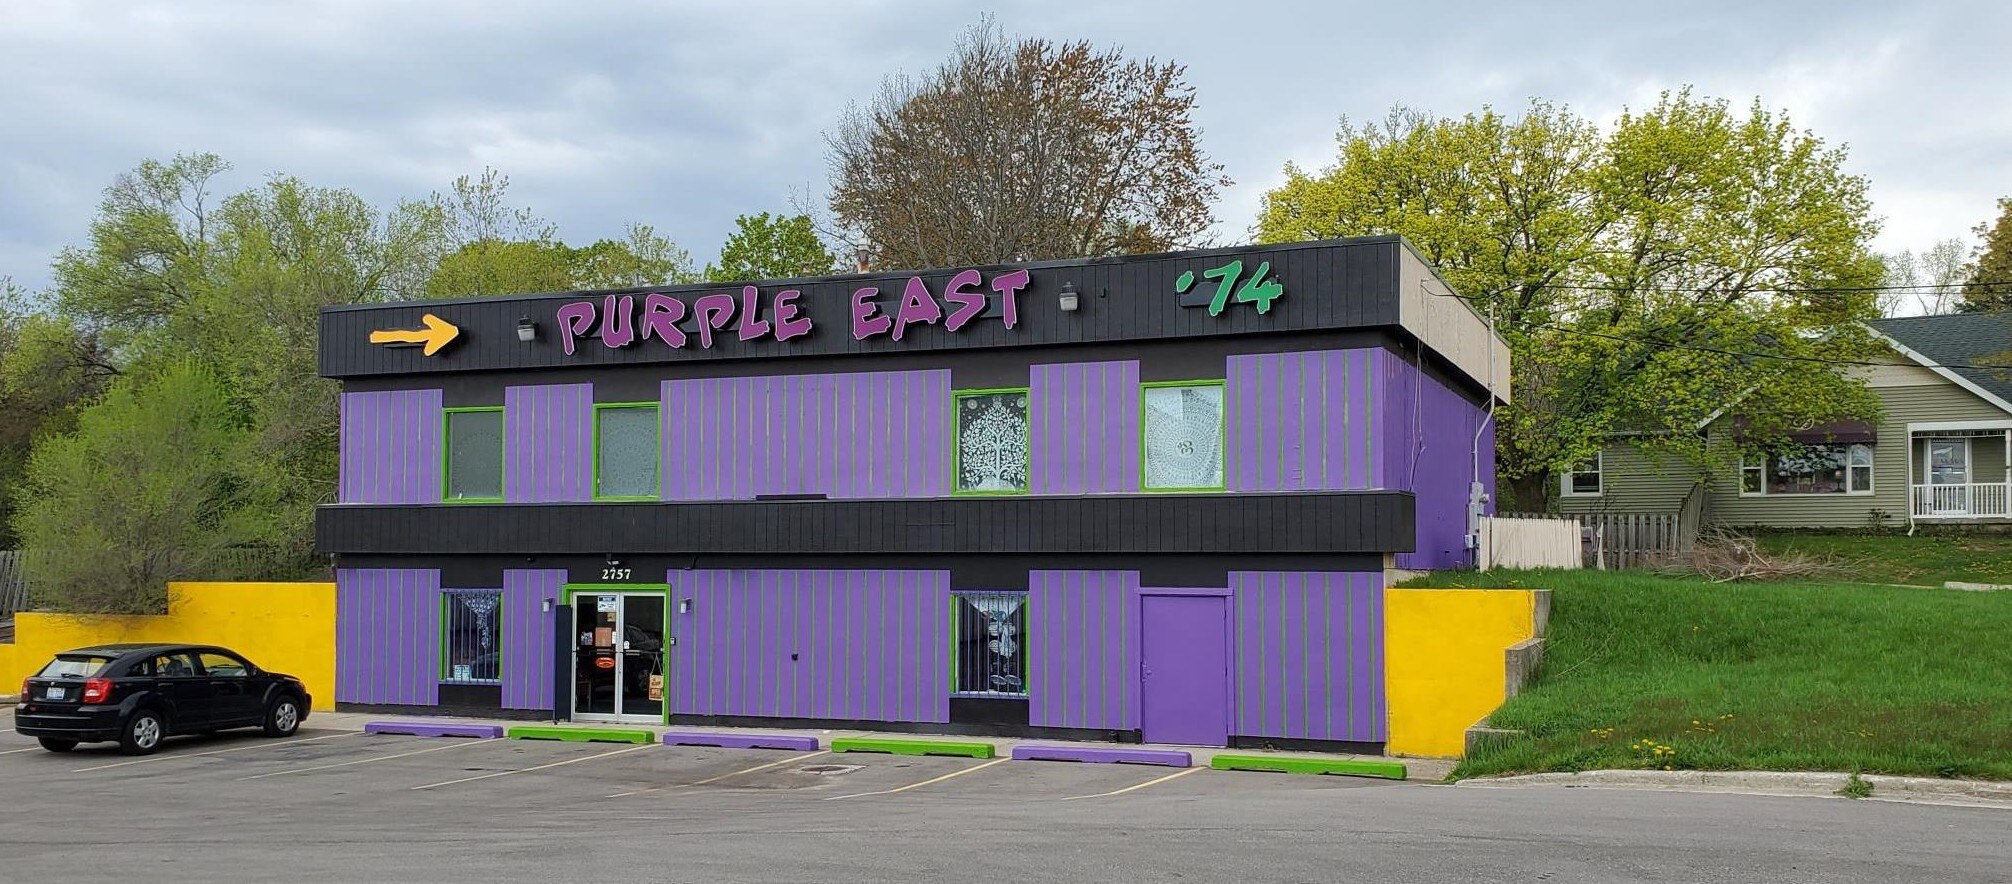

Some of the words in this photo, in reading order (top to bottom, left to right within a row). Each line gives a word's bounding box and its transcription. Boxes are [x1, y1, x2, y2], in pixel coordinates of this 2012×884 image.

[557, 285, 813, 356] PURPLE
[853, 270, 1029, 341] EAST
[1176, 260, 1283, 317] '74
[602, 569, 631, 580] 2757
